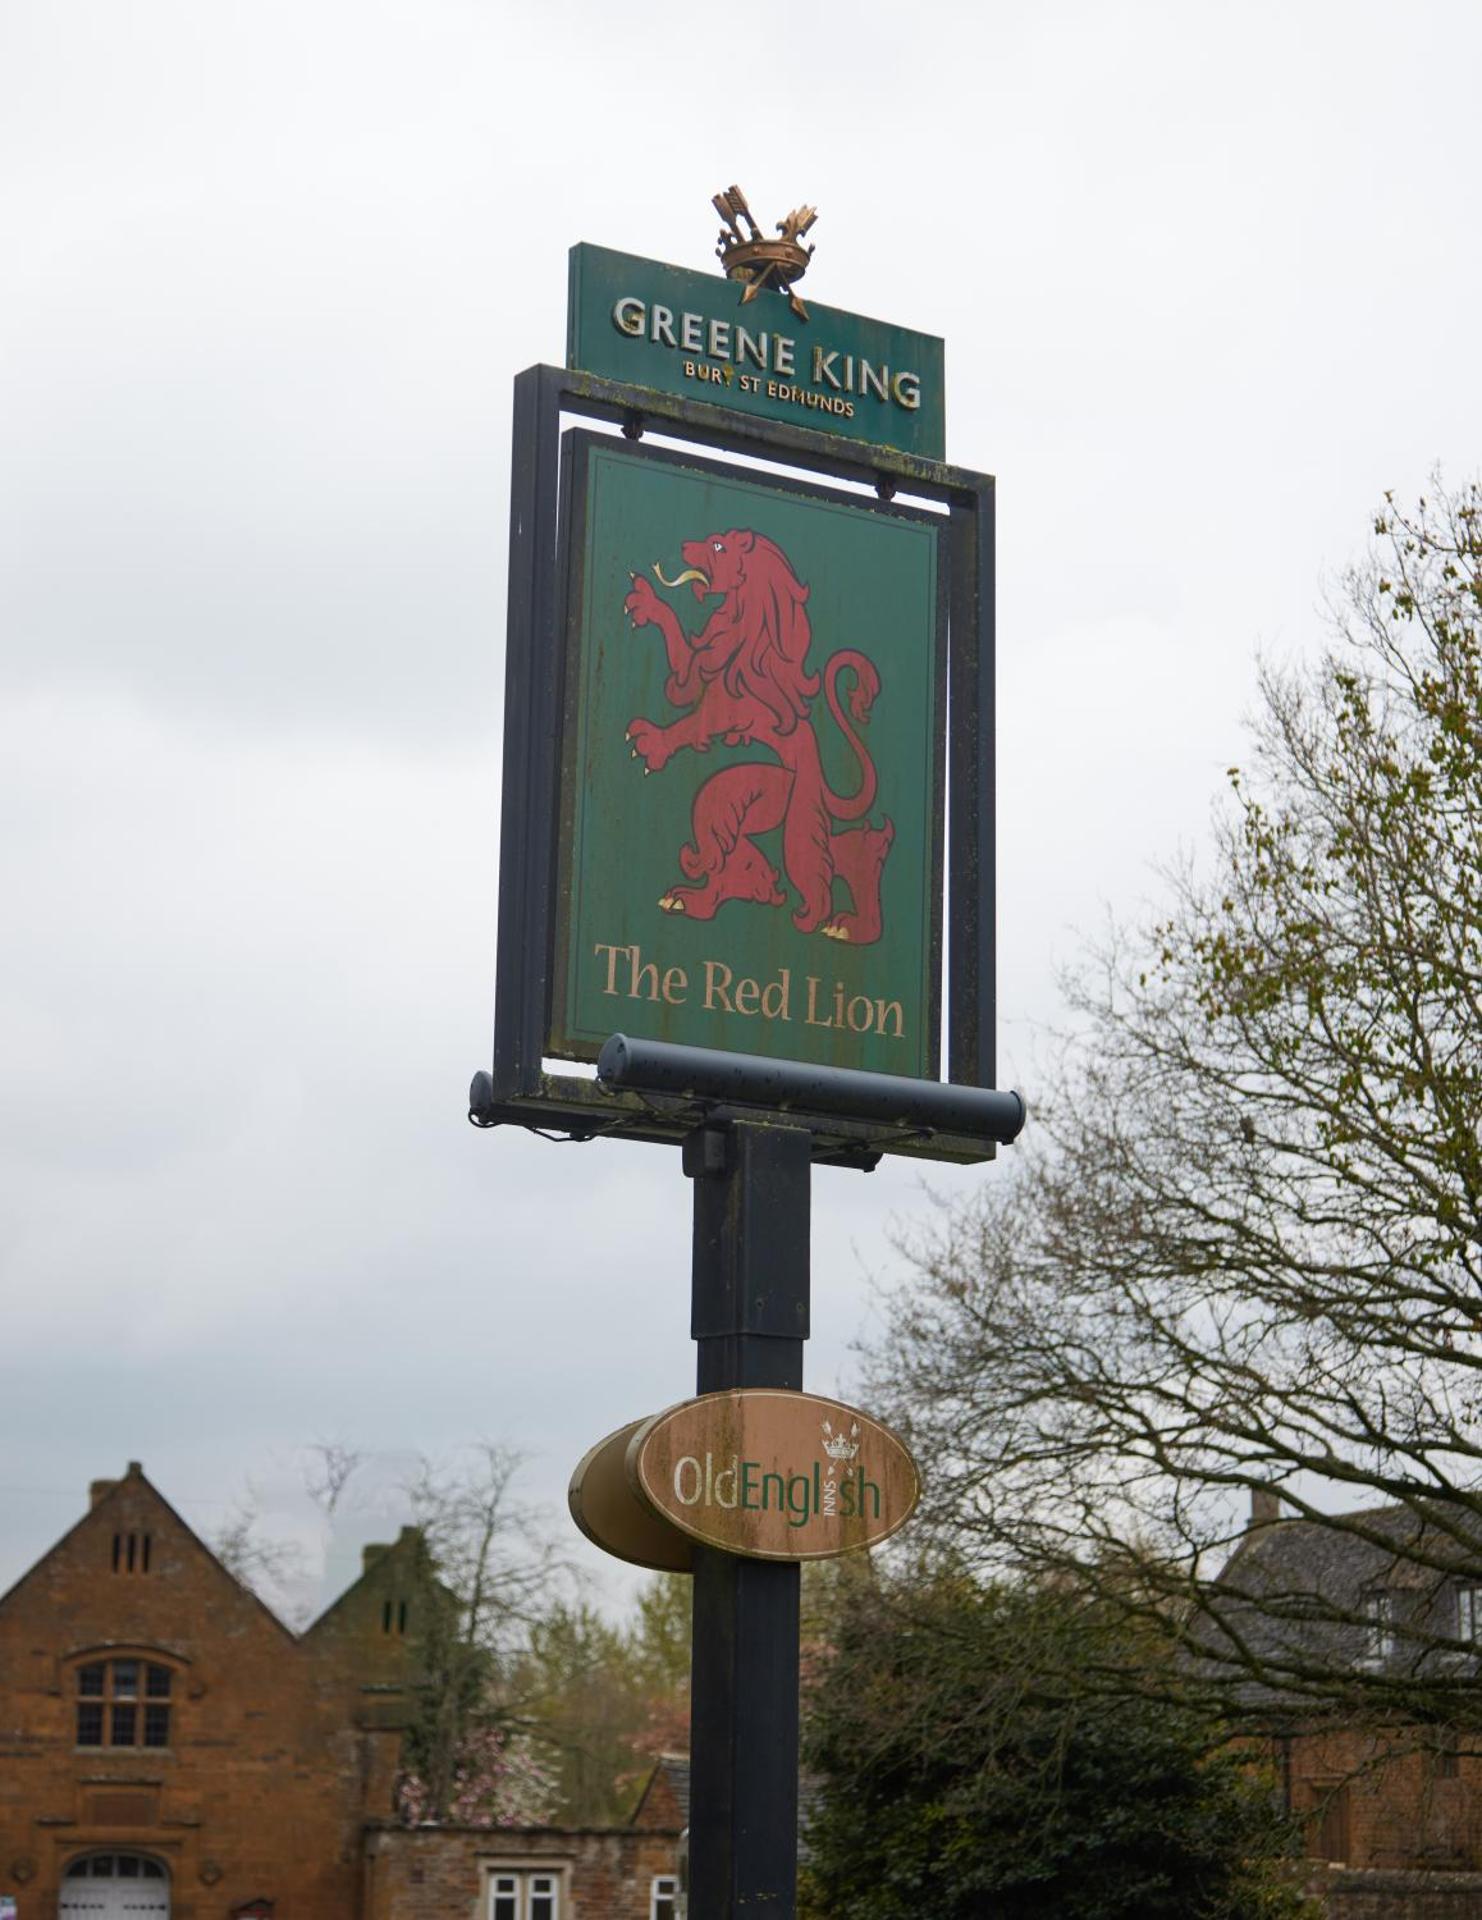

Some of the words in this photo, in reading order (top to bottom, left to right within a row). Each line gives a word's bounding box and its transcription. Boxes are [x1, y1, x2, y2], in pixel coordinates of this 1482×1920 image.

[613, 297, 795, 375] GREENE
[813, 346, 921, 410] KING
[739, 373, 761, 393] ST
[767, 380, 856, 418] EDMUNDS
[595, 944, 688, 1005] The
[702, 960, 792, 1021] Red
[804, 976, 905, 1038] Lion
[823, 1480, 838, 1518] INNS
